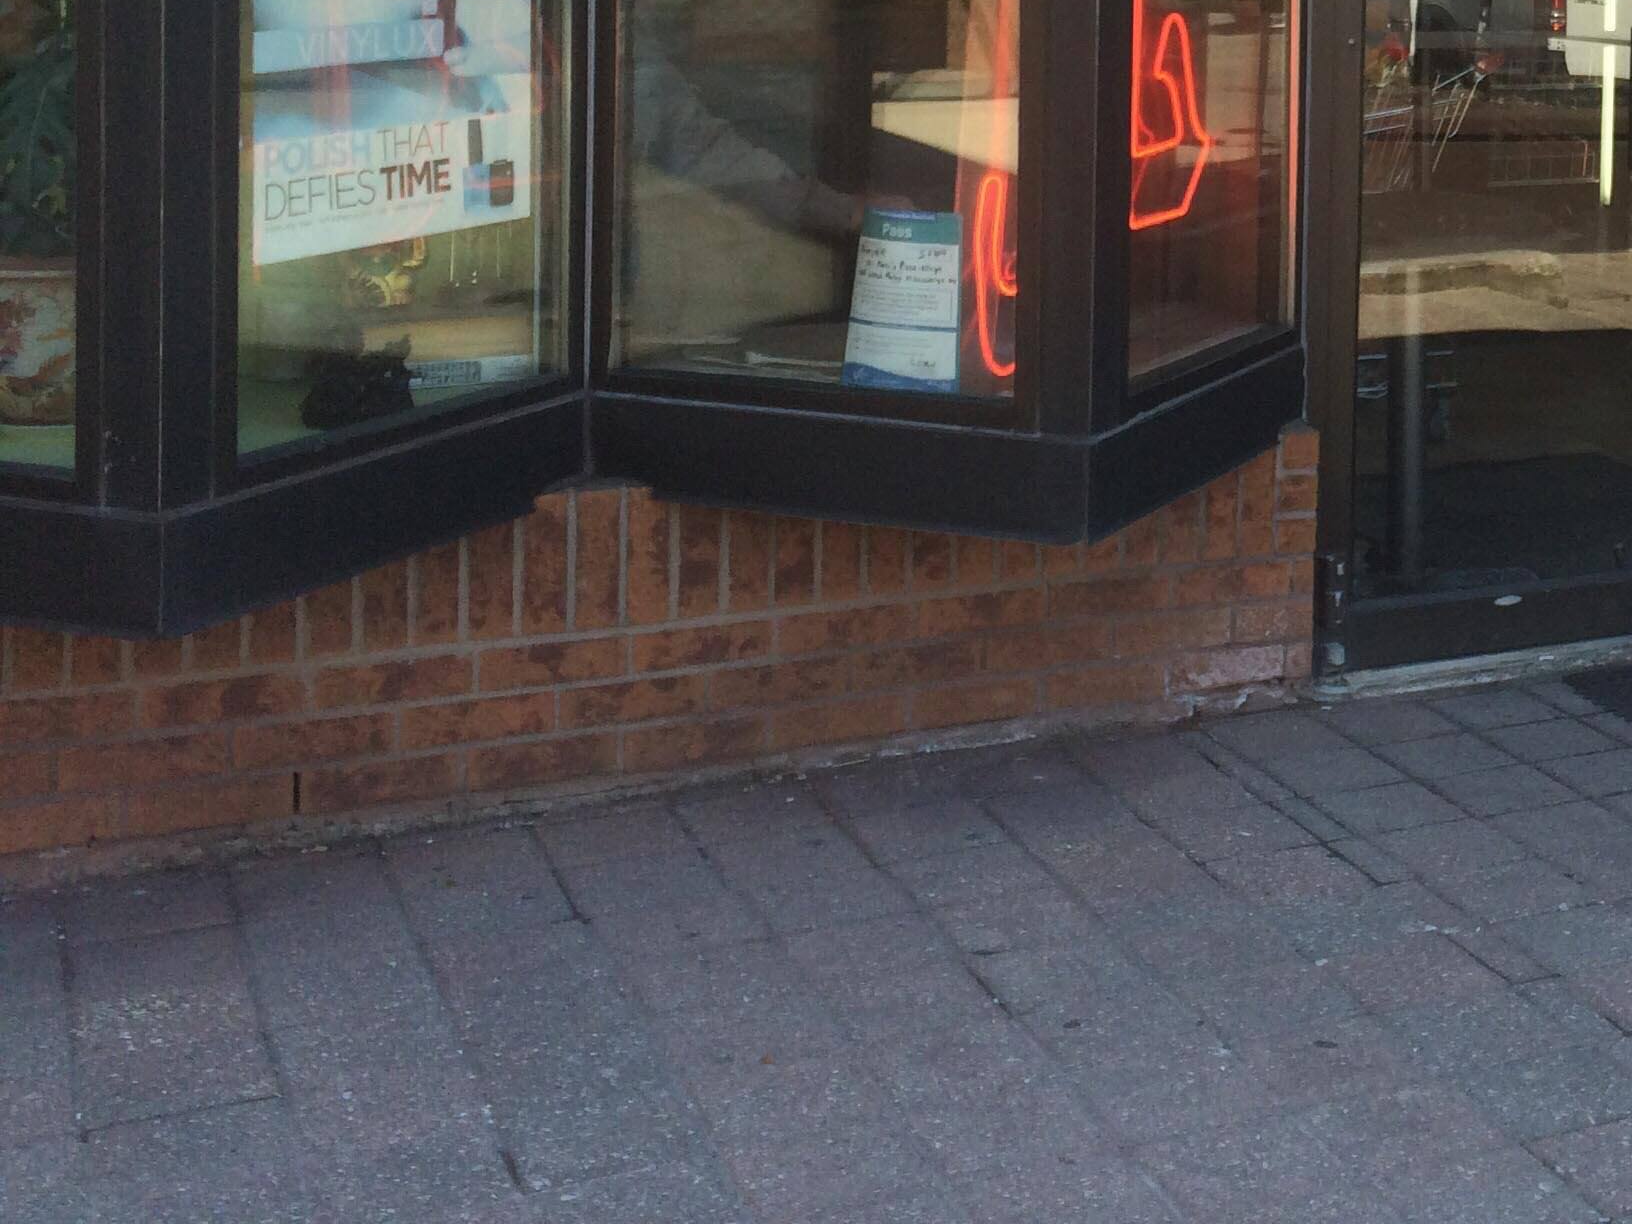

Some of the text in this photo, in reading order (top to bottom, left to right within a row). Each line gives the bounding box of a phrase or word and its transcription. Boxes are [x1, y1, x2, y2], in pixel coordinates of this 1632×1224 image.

[264, 121, 449, 176] POLISH THAT
[264, 158, 452, 221] DEFIES TIME
